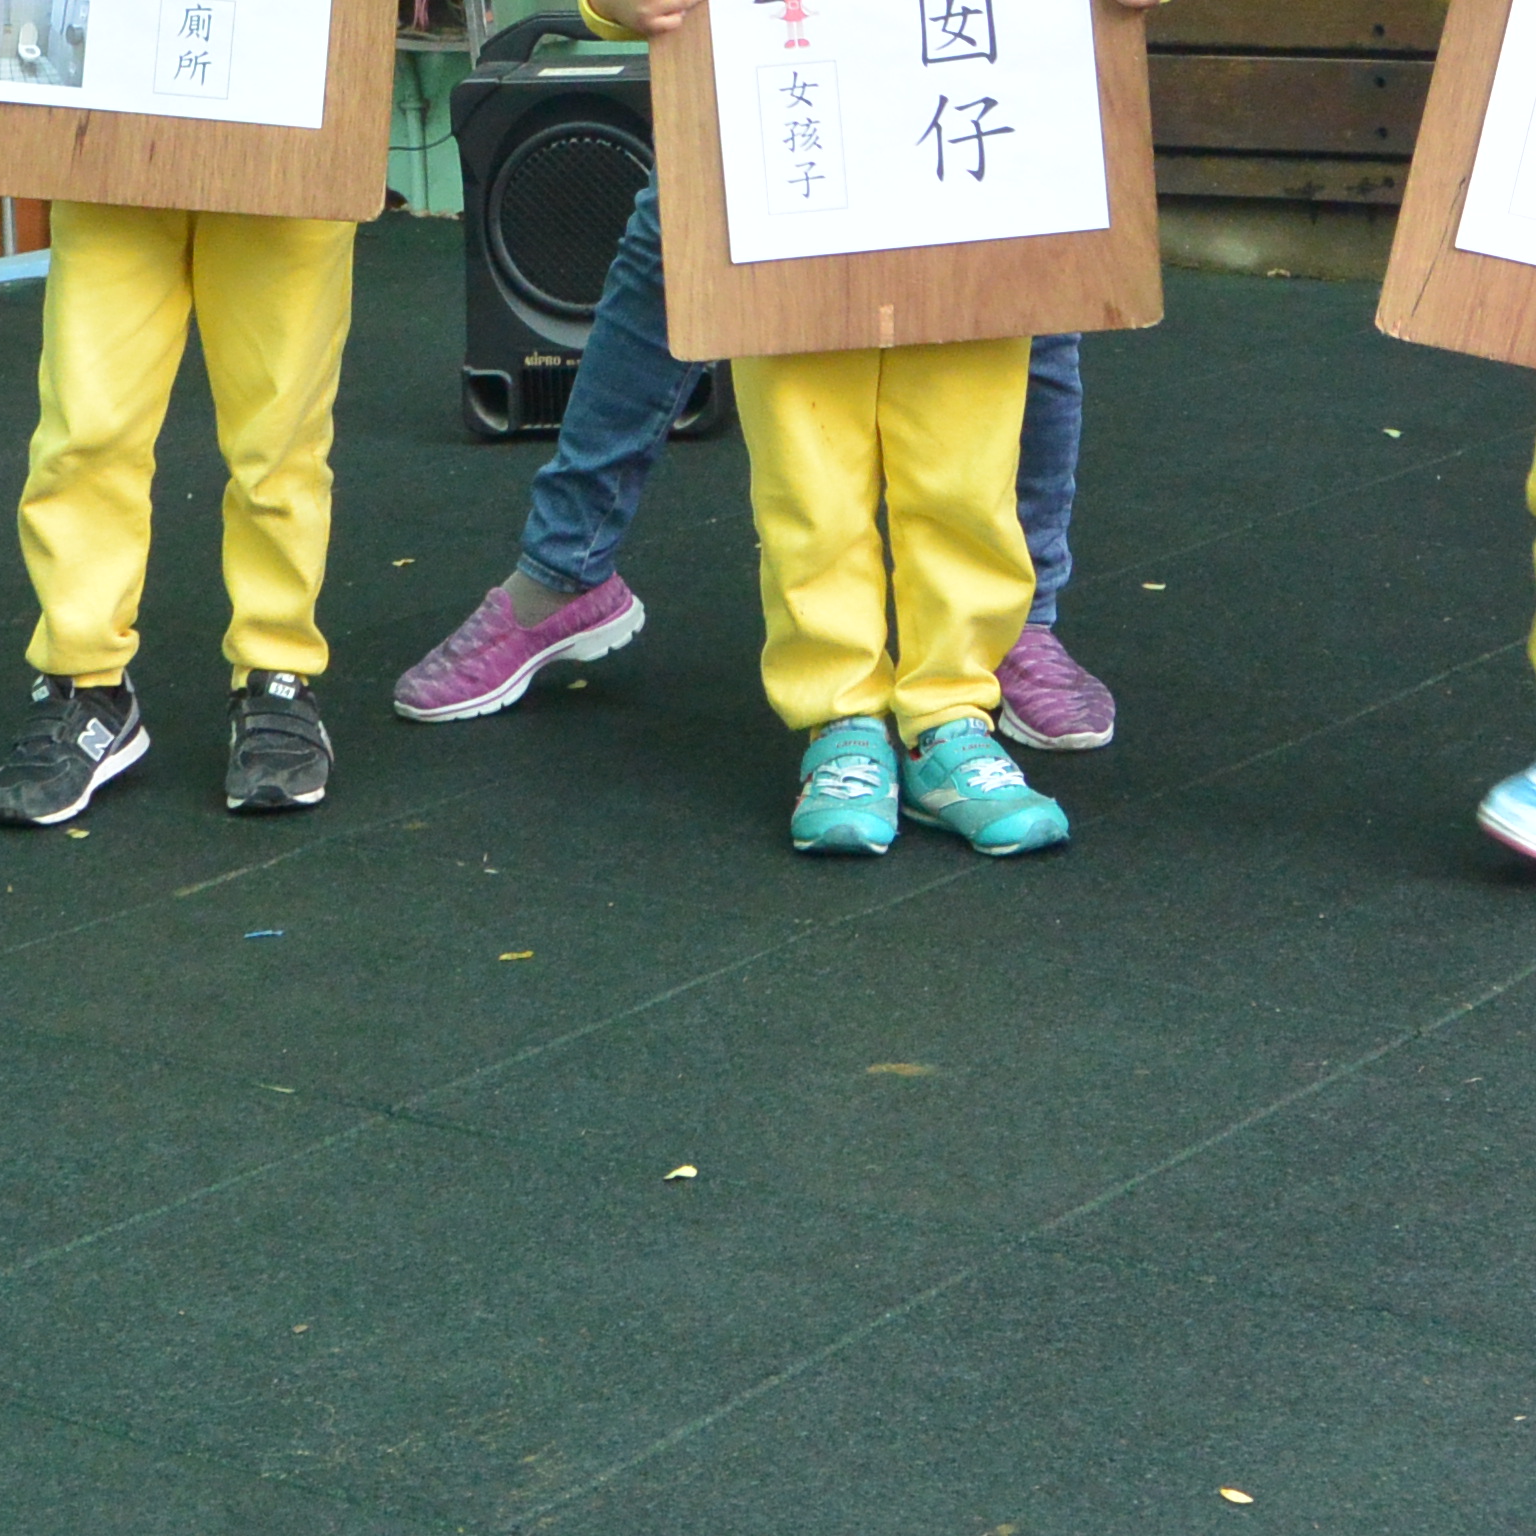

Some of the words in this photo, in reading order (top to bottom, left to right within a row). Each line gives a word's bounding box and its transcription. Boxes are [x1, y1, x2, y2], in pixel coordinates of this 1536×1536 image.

[173, 3, 213, 86] 廁所
[779, 71, 826, 199] 女孩子
